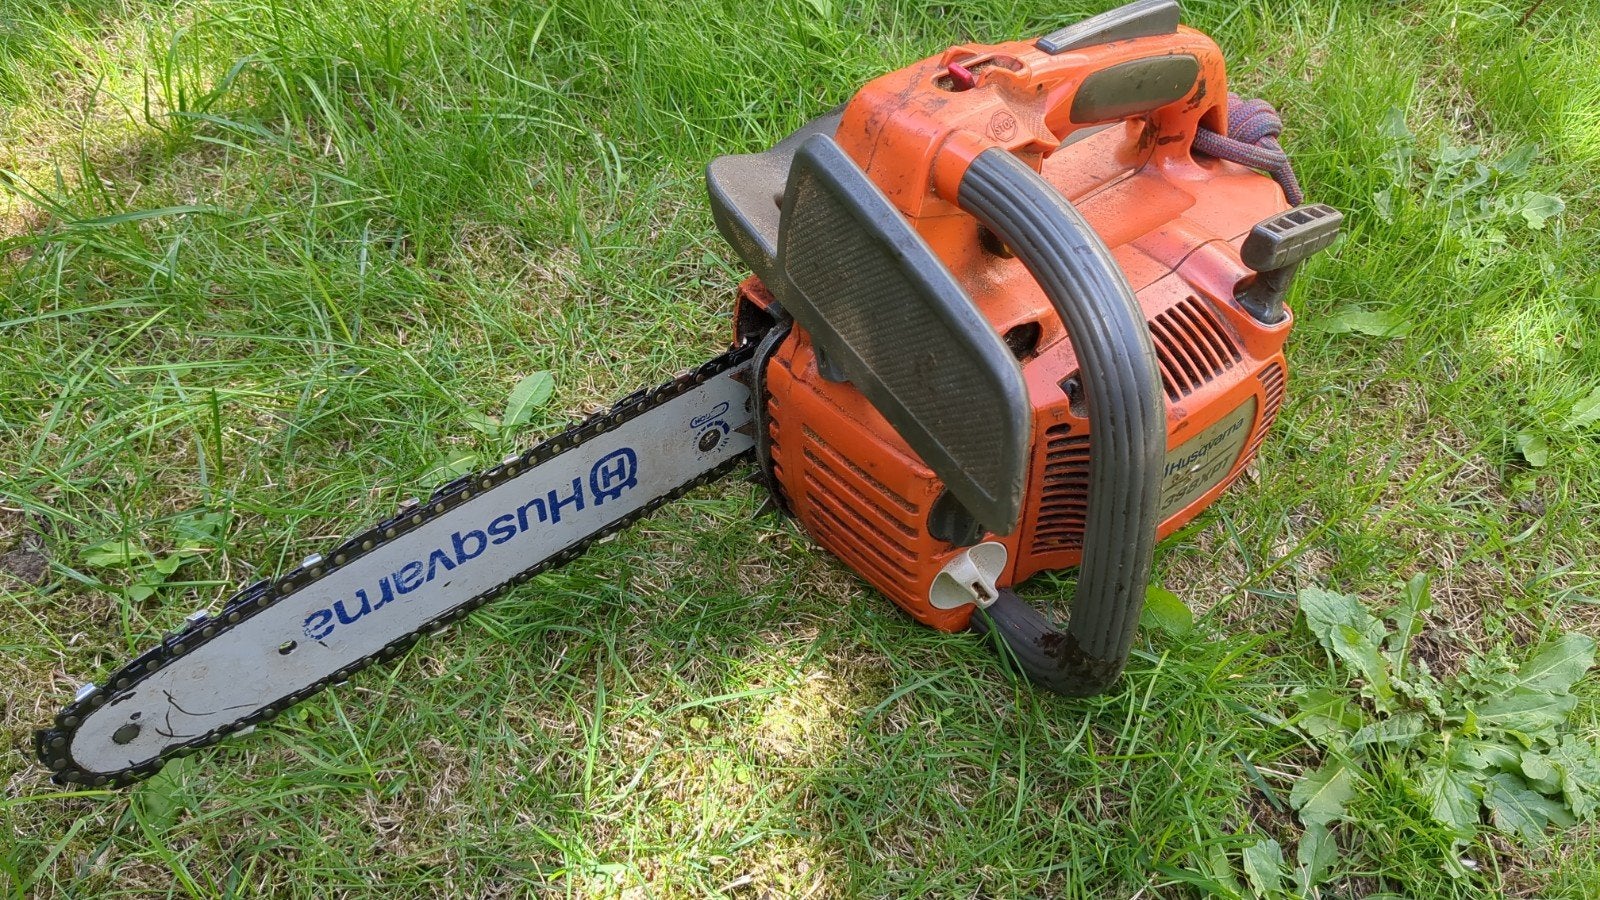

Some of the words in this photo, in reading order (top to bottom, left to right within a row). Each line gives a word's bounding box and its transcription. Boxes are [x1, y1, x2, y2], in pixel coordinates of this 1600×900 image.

[994, 117, 1014, 135] STOP
[1169, 418, 1245, 475] Husqvarna
[303, 477, 583, 641] Husqvarna
